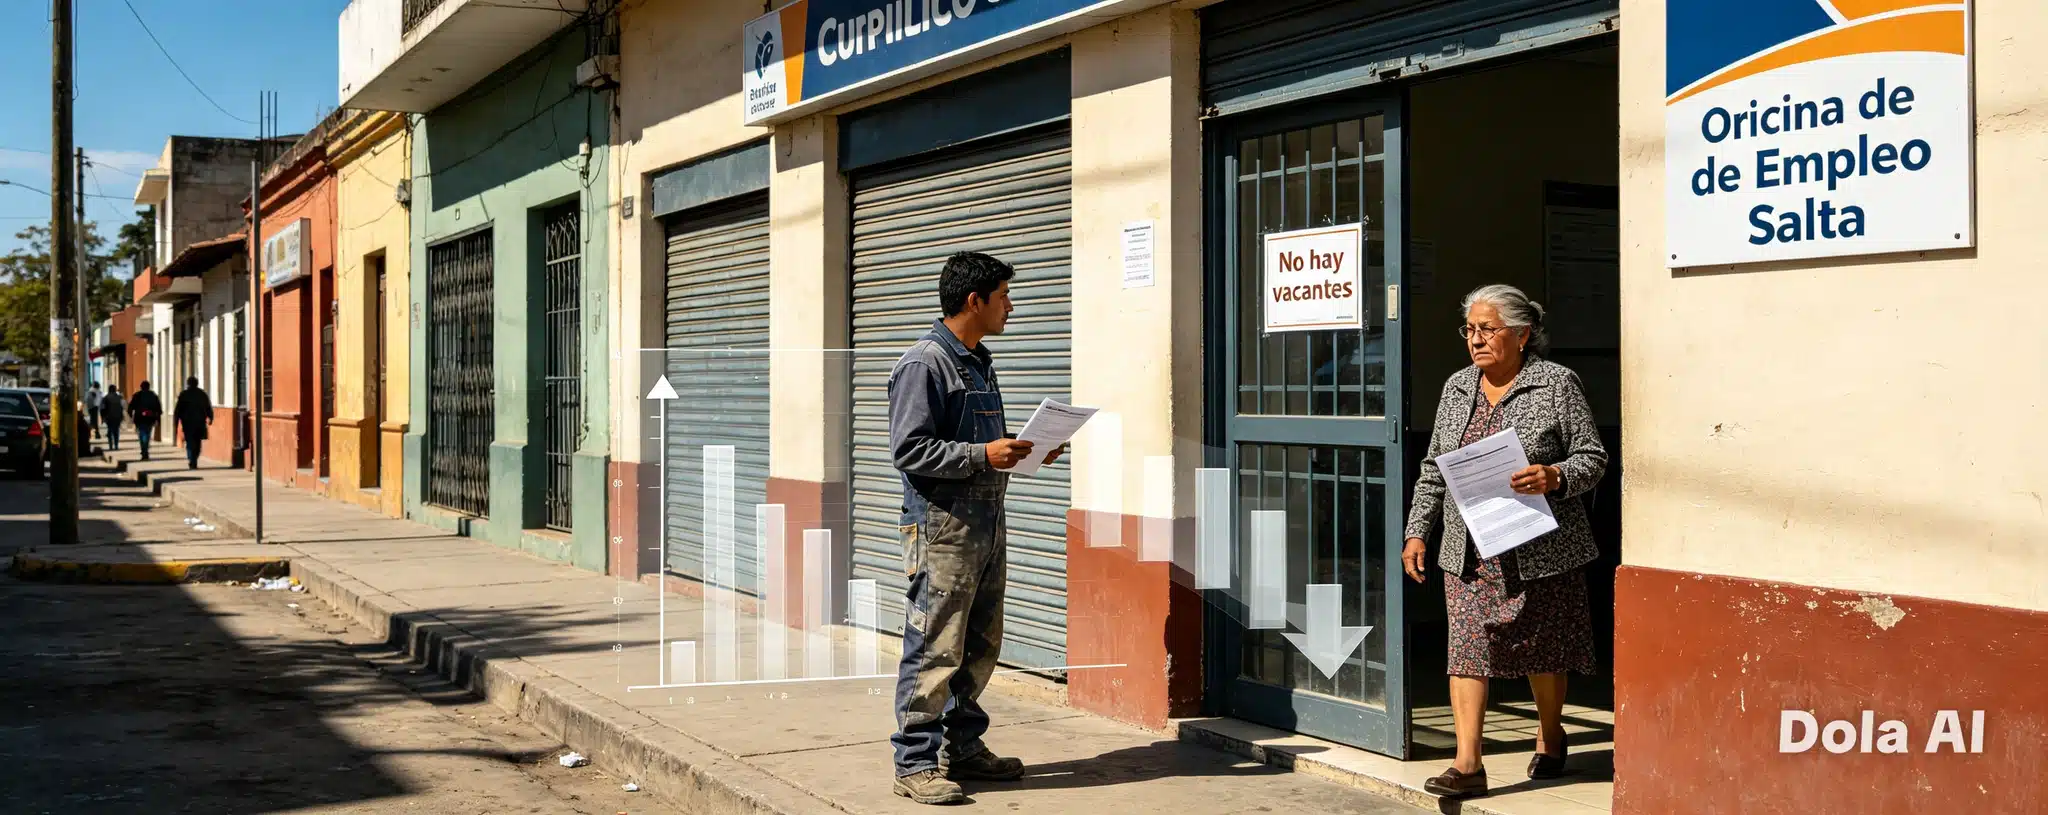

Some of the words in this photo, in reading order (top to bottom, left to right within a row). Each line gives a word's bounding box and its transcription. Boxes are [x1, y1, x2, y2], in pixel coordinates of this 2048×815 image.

[1701, 93, 1844, 143] Oricina
[1858, 77, 1915, 120] de
[1691, 156, 1741, 197] de
[1756, 133, 1932, 191] Empleo
[1748, 197, 1865, 246] Salta
[1279, 250, 1305, 273] No
[1309, 248, 1345, 274] hay
[1272, 279, 1353, 303] vacantes
